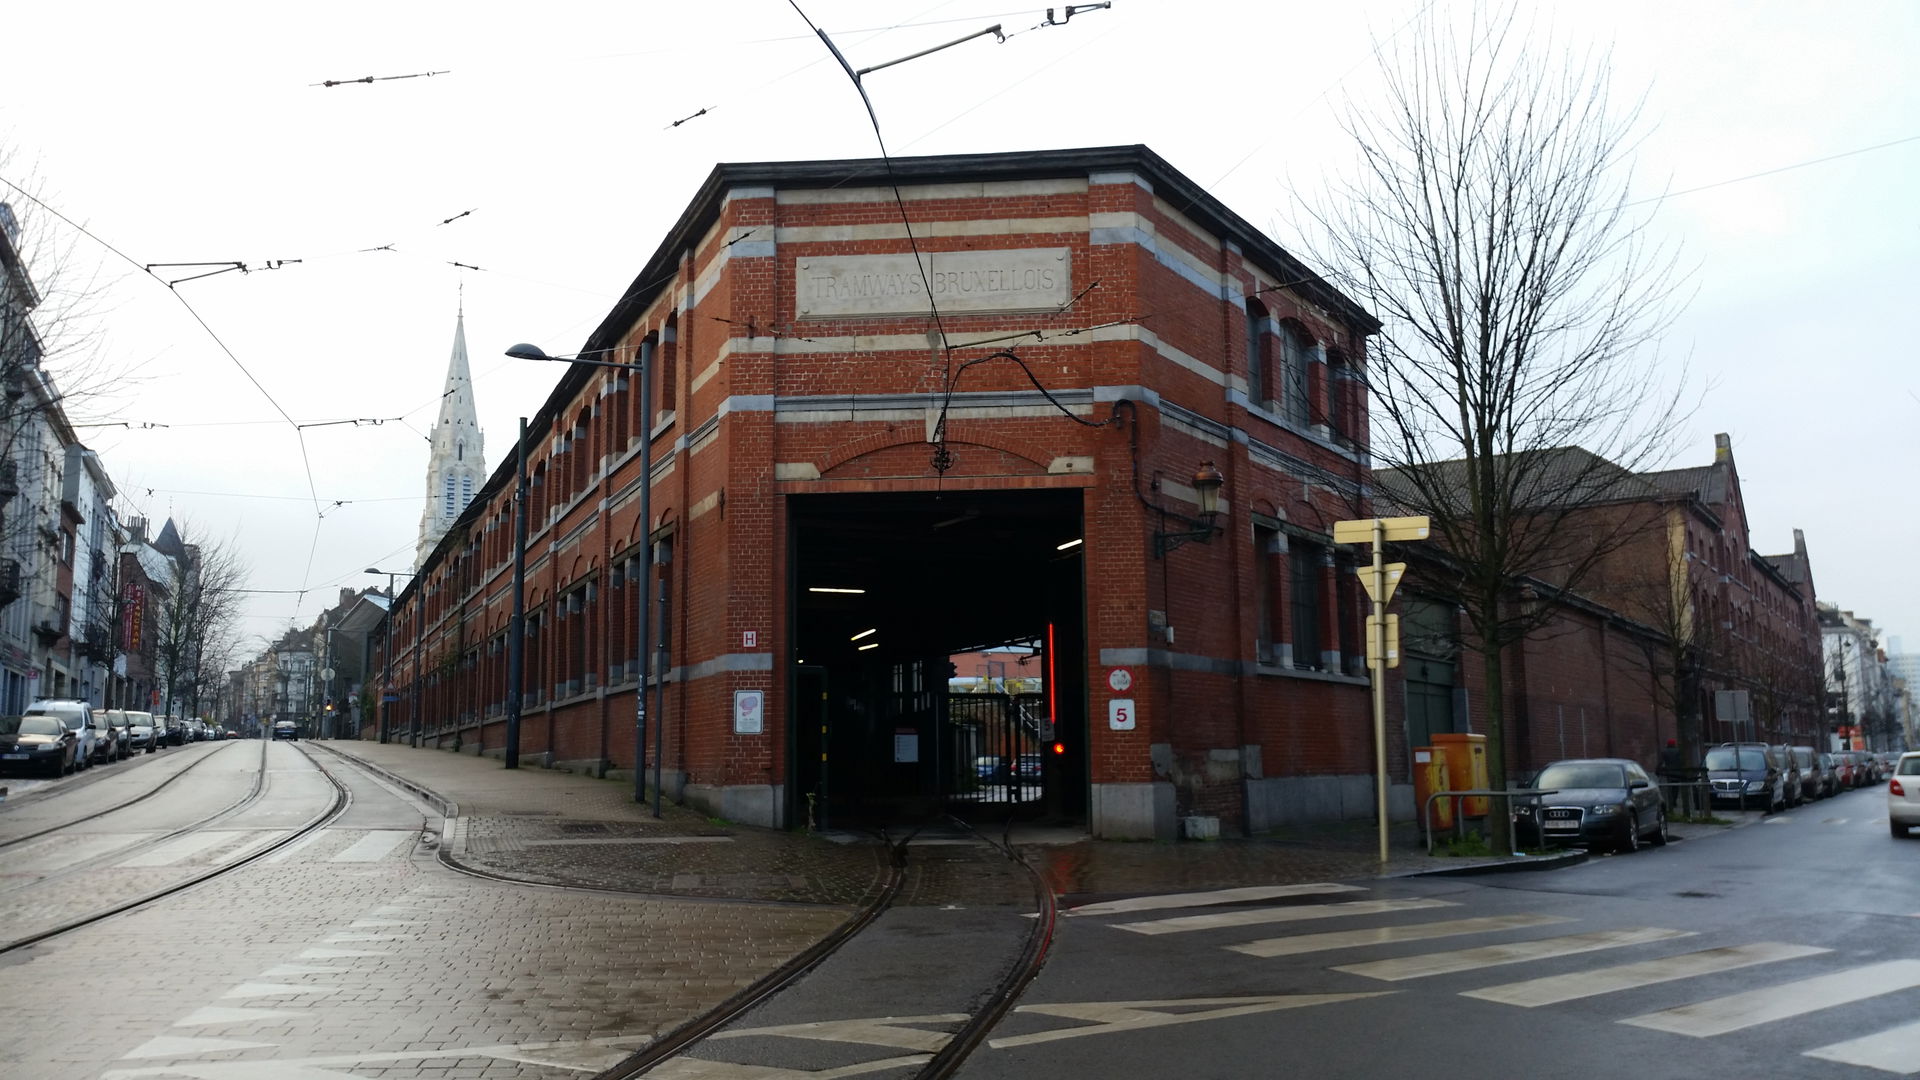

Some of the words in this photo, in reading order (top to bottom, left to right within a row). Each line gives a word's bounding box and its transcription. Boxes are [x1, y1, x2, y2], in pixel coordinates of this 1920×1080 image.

[811, 273, 921, 298] TRAMWAYS
[935, 269, 1054, 296] BRUXELLOIS
[745, 632, 754, 646] H
[1116, 708, 1127, 722] 5
